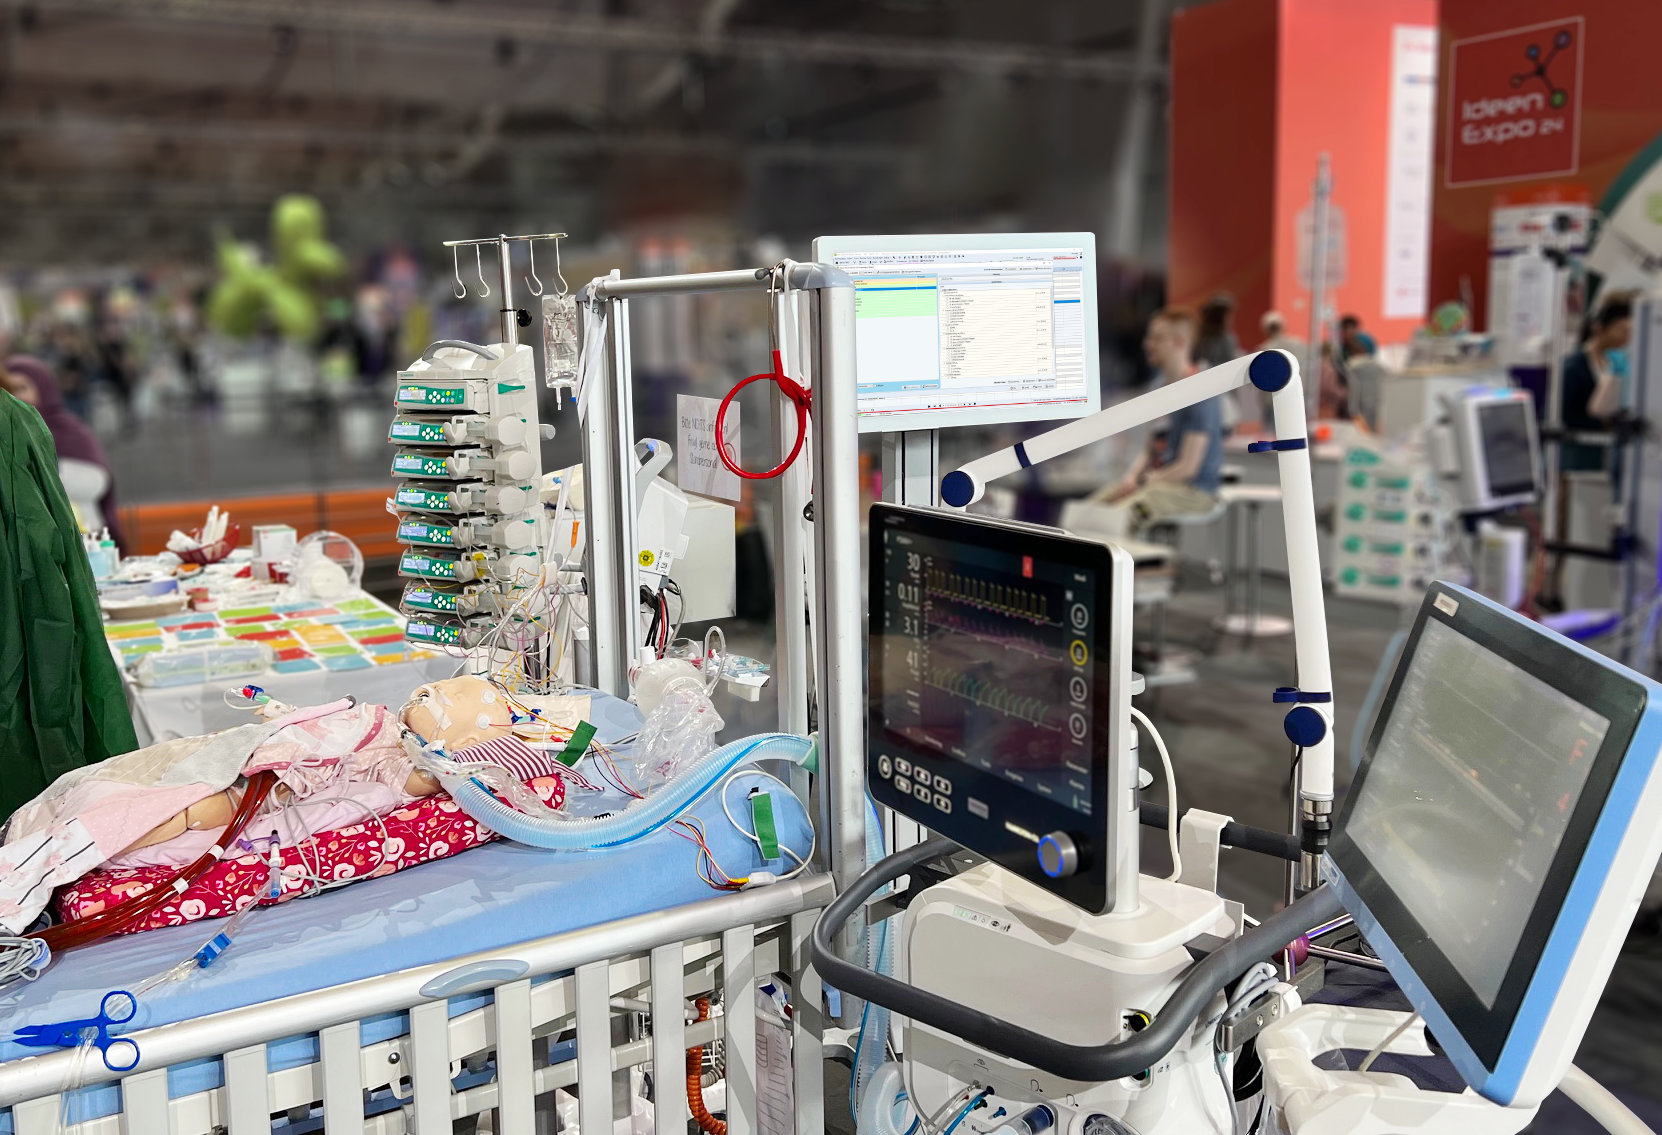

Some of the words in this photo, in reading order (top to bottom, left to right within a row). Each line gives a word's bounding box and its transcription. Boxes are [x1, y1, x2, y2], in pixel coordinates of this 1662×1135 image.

[1462, 93, 1544, 120] Ideen
[1462, 118, 1536, 145] Expo
[906, 552, 920, 571] 30
[898, 583, 919, 603] 0.11
[904, 616, 918, 636] 3.1
